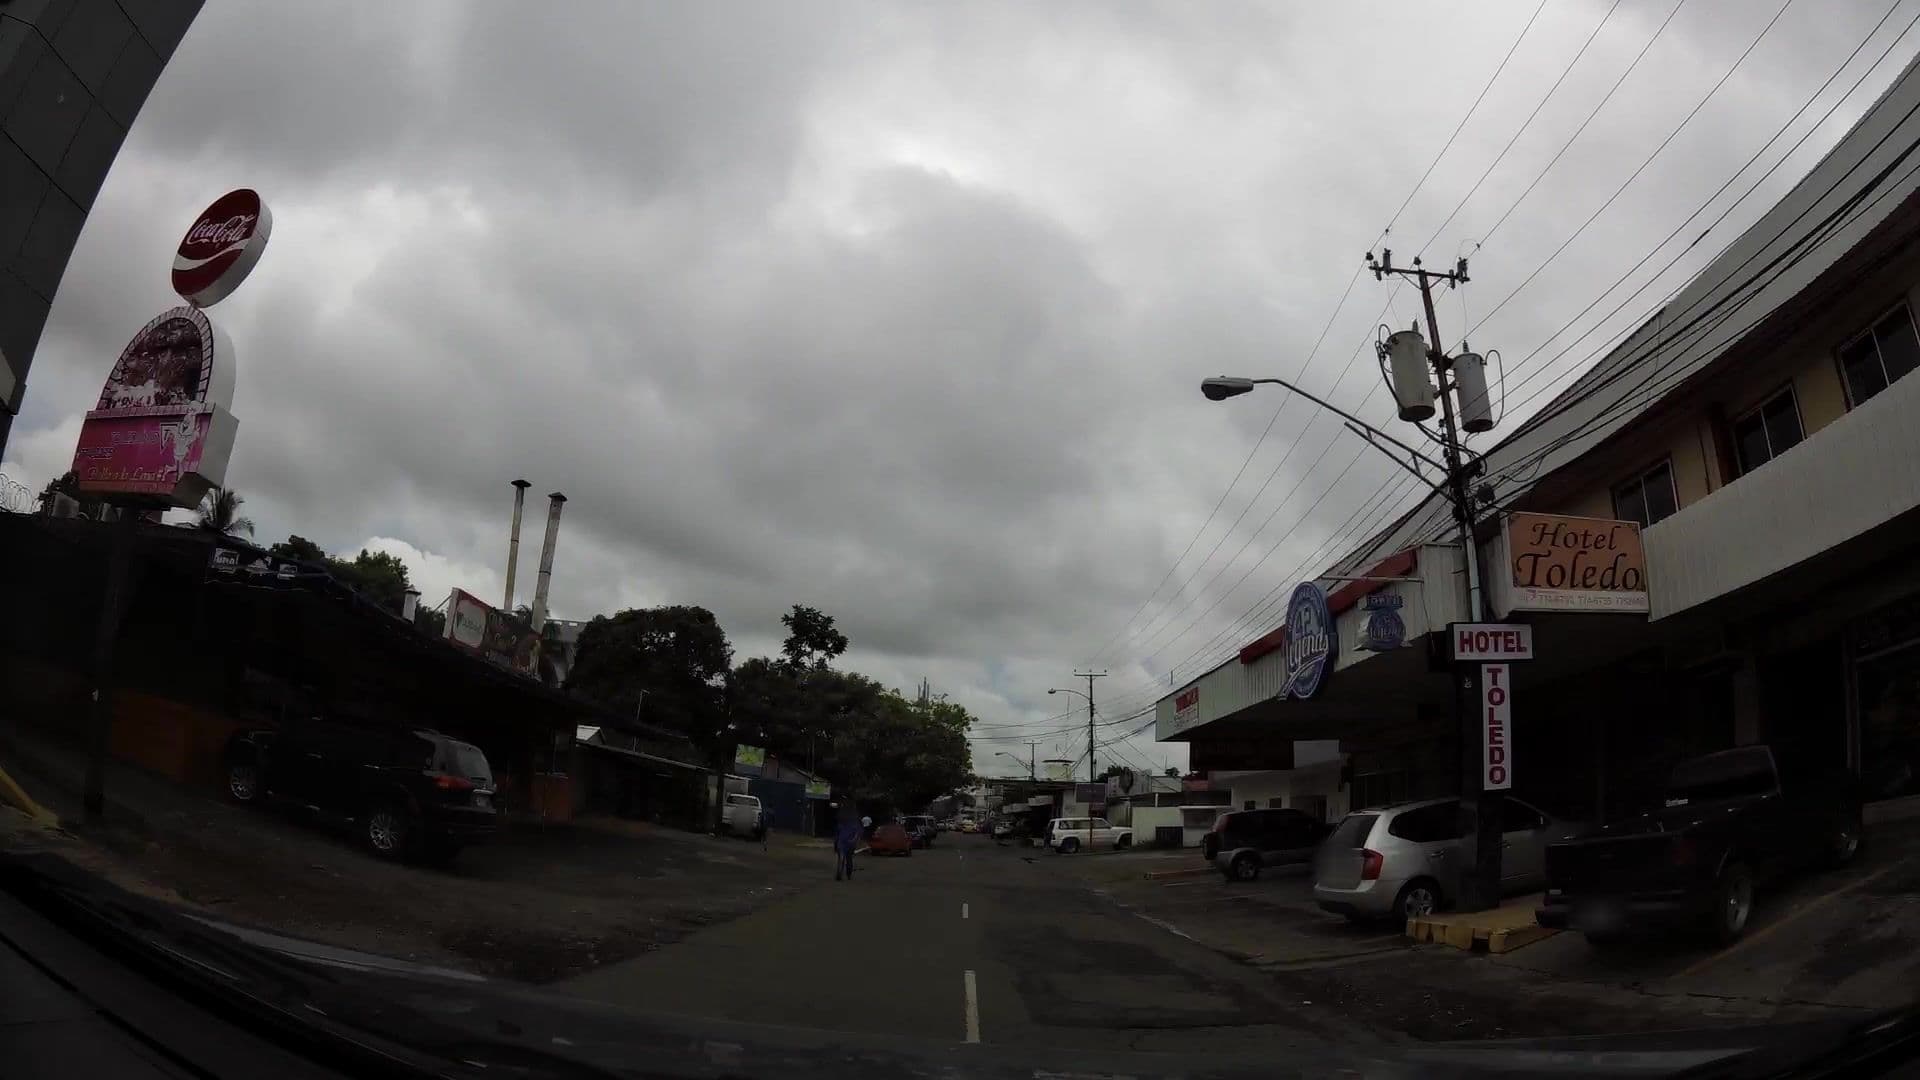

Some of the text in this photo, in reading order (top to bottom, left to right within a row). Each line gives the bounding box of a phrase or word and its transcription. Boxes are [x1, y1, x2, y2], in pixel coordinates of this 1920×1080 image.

[1531, 523, 1621, 550] Hotel
[1516, 550, 1641, 590] Toledo
[1460, 631, 1527, 653] HOTEL
[1487, 668, 1506, 785] TOLEDO
